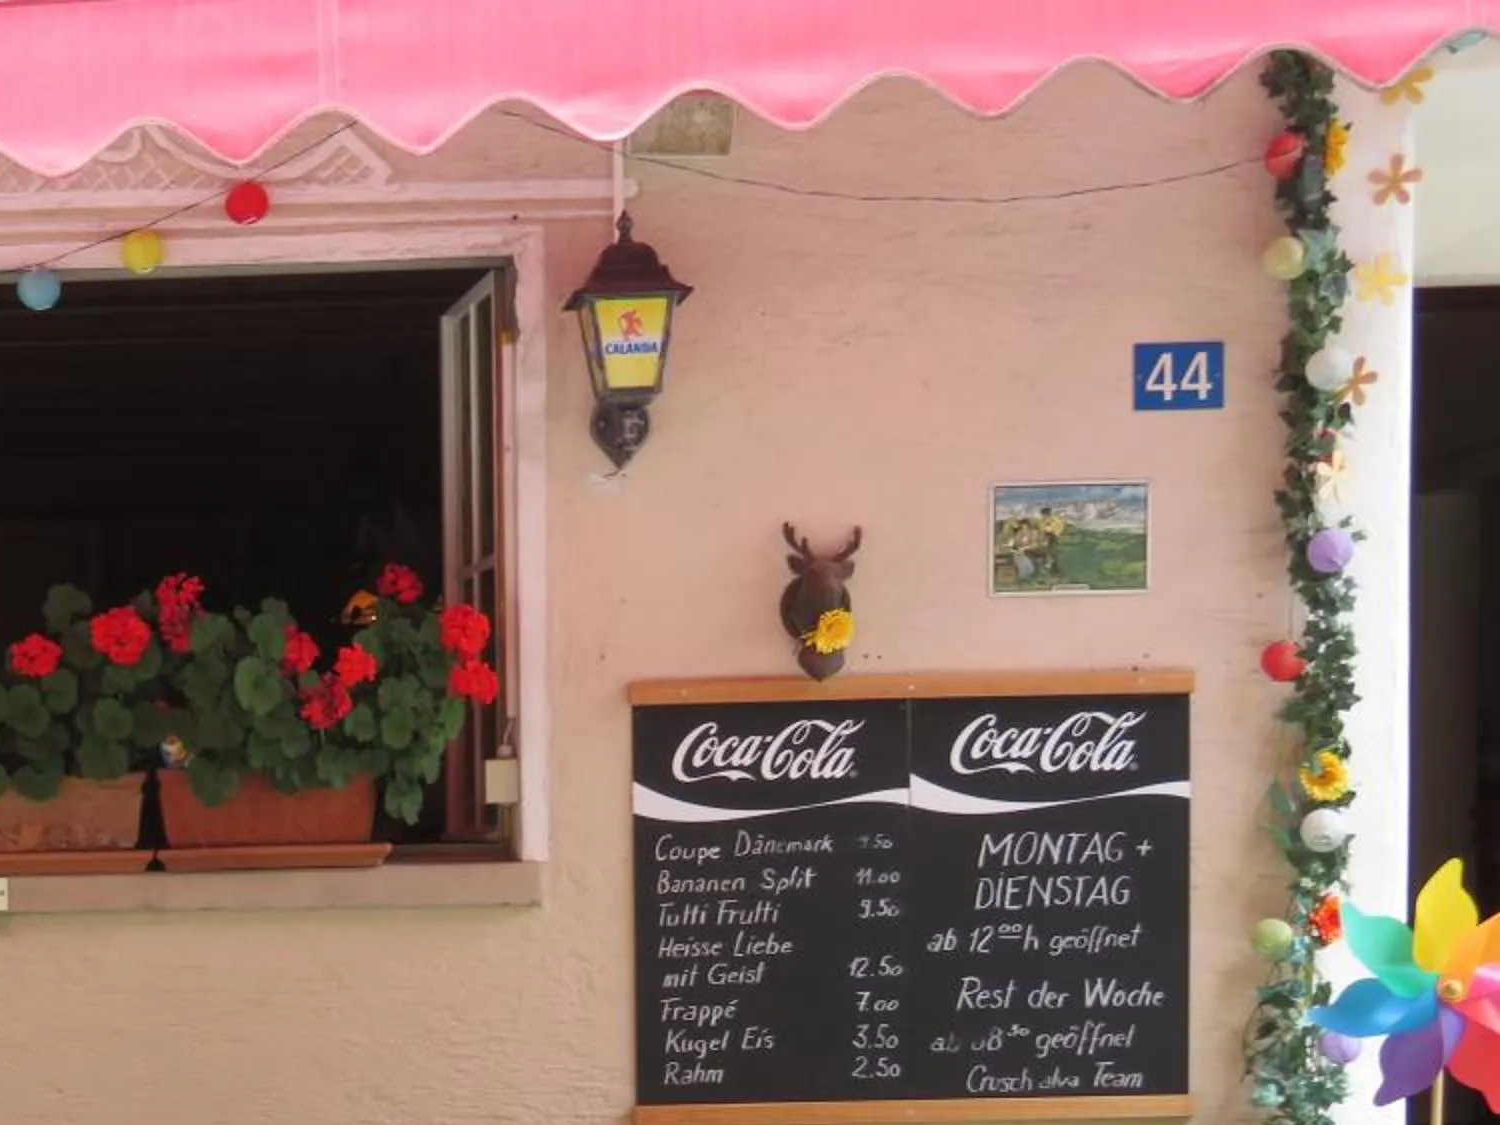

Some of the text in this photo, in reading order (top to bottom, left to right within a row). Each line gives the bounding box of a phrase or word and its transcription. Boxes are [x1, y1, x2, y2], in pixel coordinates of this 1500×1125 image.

[604, 341, 659, 354] CALANDA
[1145, 351, 1212, 401] 44
[654, 833, 721, 864] Coupe
[977, 831, 1128, 869] MONTAG
[656, 869, 746, 894] Bananen
[759, 866, 816, 895] Split
[974, 872, 1132, 910] DIENSTAG
[658, 902, 707, 928] Tutti
[717, 899, 781, 926] Frutti
[657, 930, 793, 959] Heisse Liebe
[926, 927, 957, 952] ab
[1049, 922, 1142, 956] geöffnet
[662, 955, 903, 988] mit Geist 12.50
[956, 975, 1167, 1012] Rest der Woche
[660, 997, 739, 1027] Frappé
[664, 1023, 900, 1060] Kugel Eis 3.50
[663, 1055, 901, 1086] Rahm 2.50
[1093, 1060, 1145, 1089] Team
